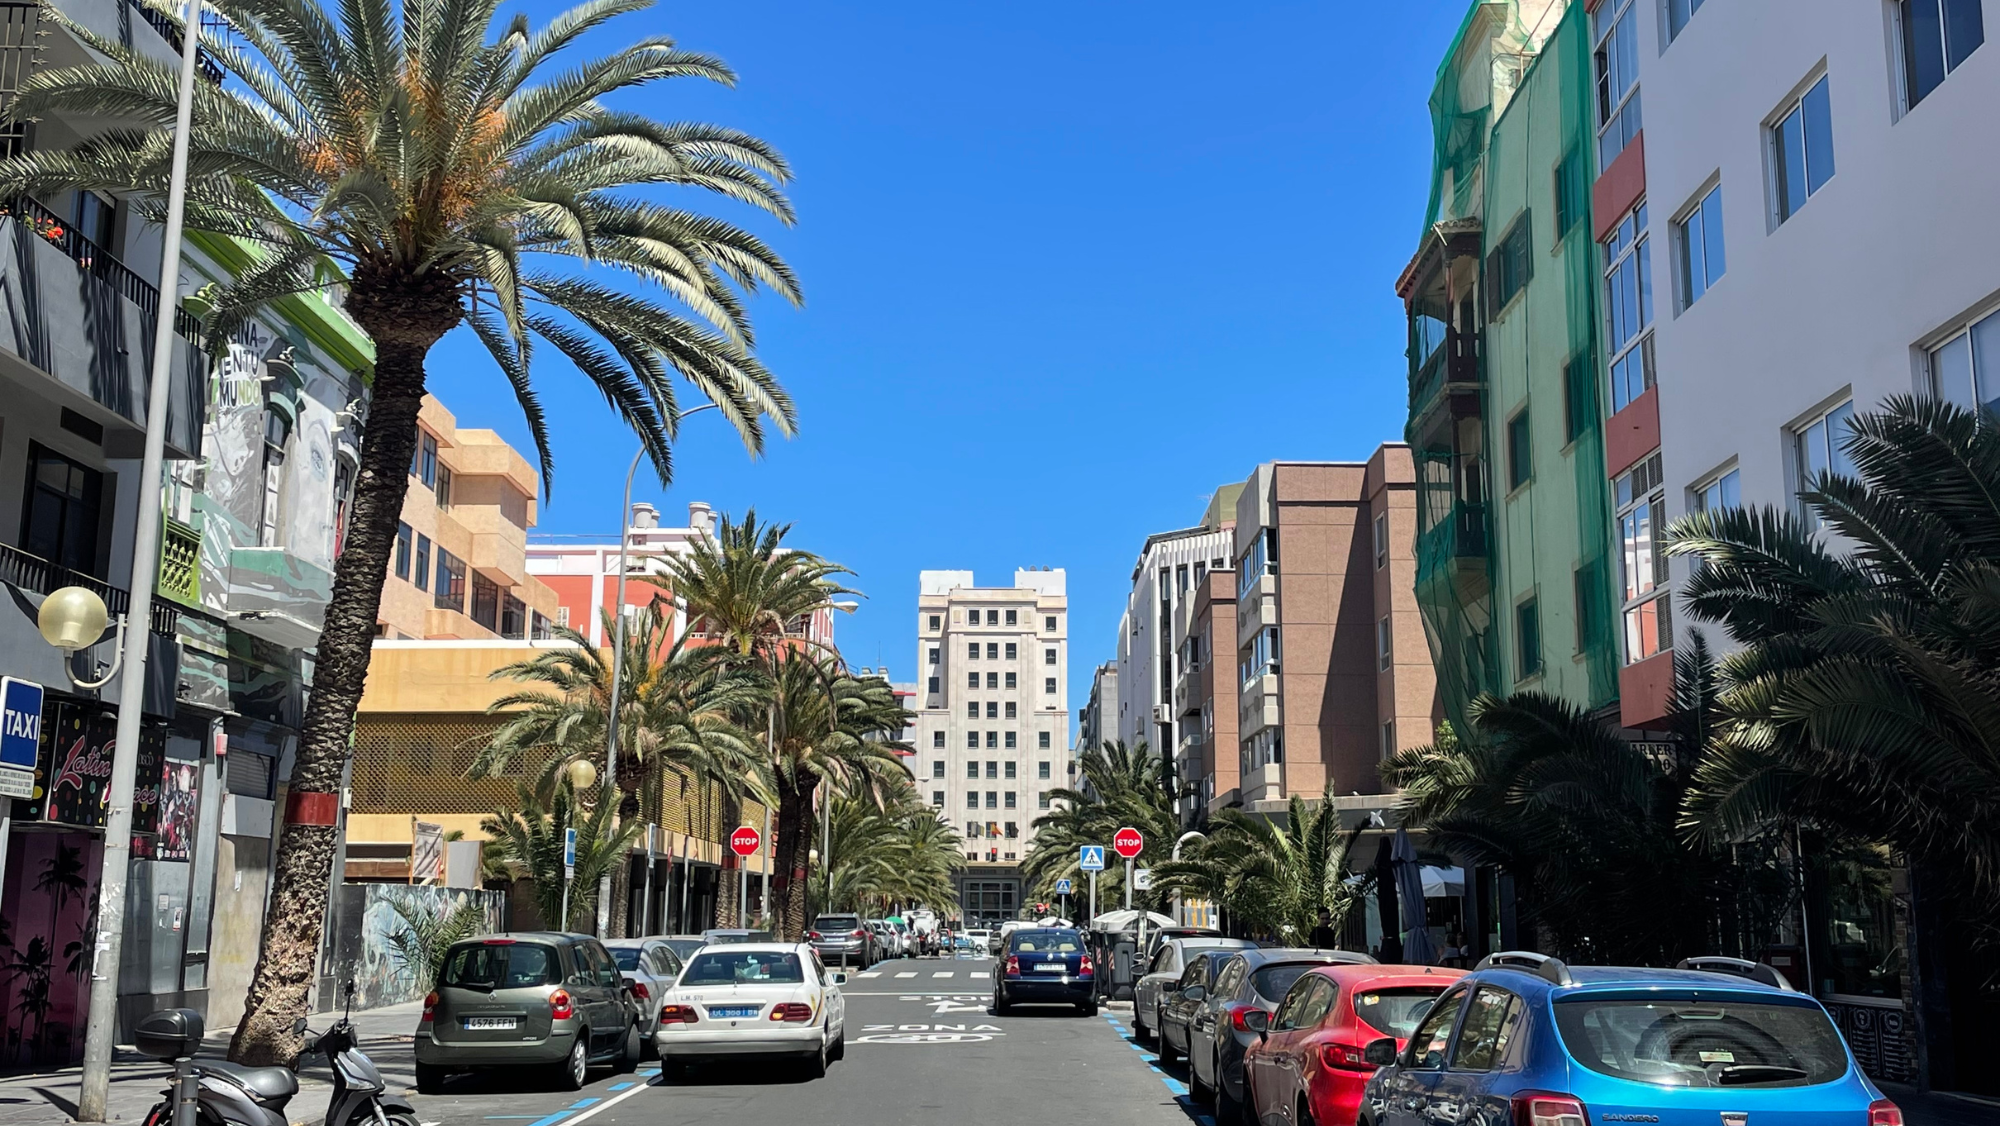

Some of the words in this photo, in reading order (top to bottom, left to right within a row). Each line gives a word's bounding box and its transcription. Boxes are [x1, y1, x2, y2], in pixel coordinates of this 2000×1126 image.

[219, 378, 261, 408] MUNDO
[5, 708, 39, 741] TAXI
[53, 735, 112, 792] Latin
[733, 837, 758, 846] STOP
[1117, 838, 1140, 847] STOP
[471, 1018, 494, 1028] 4576
[497, 1018, 515, 1028] FFN
[861, 1024, 1003, 1032] ZONA
[1602, 1113, 1660, 1123] SANDERO
